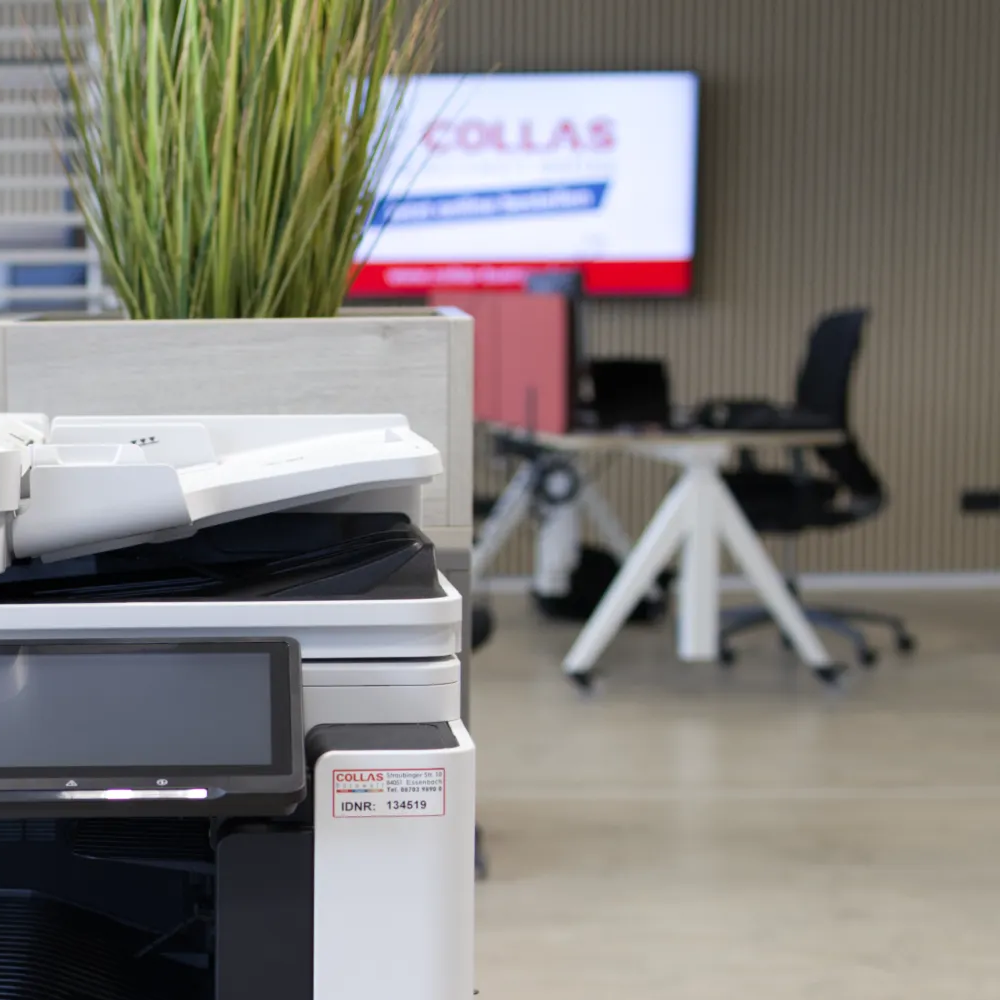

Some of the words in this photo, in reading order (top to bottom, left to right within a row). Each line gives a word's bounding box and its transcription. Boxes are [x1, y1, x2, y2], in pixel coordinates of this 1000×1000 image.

[422, 117, 616, 152] COLLAS
[336, 772, 384, 782] COLLAS
[341, 801, 376, 812] IDNR:
[386, 800, 427, 810] 134519
